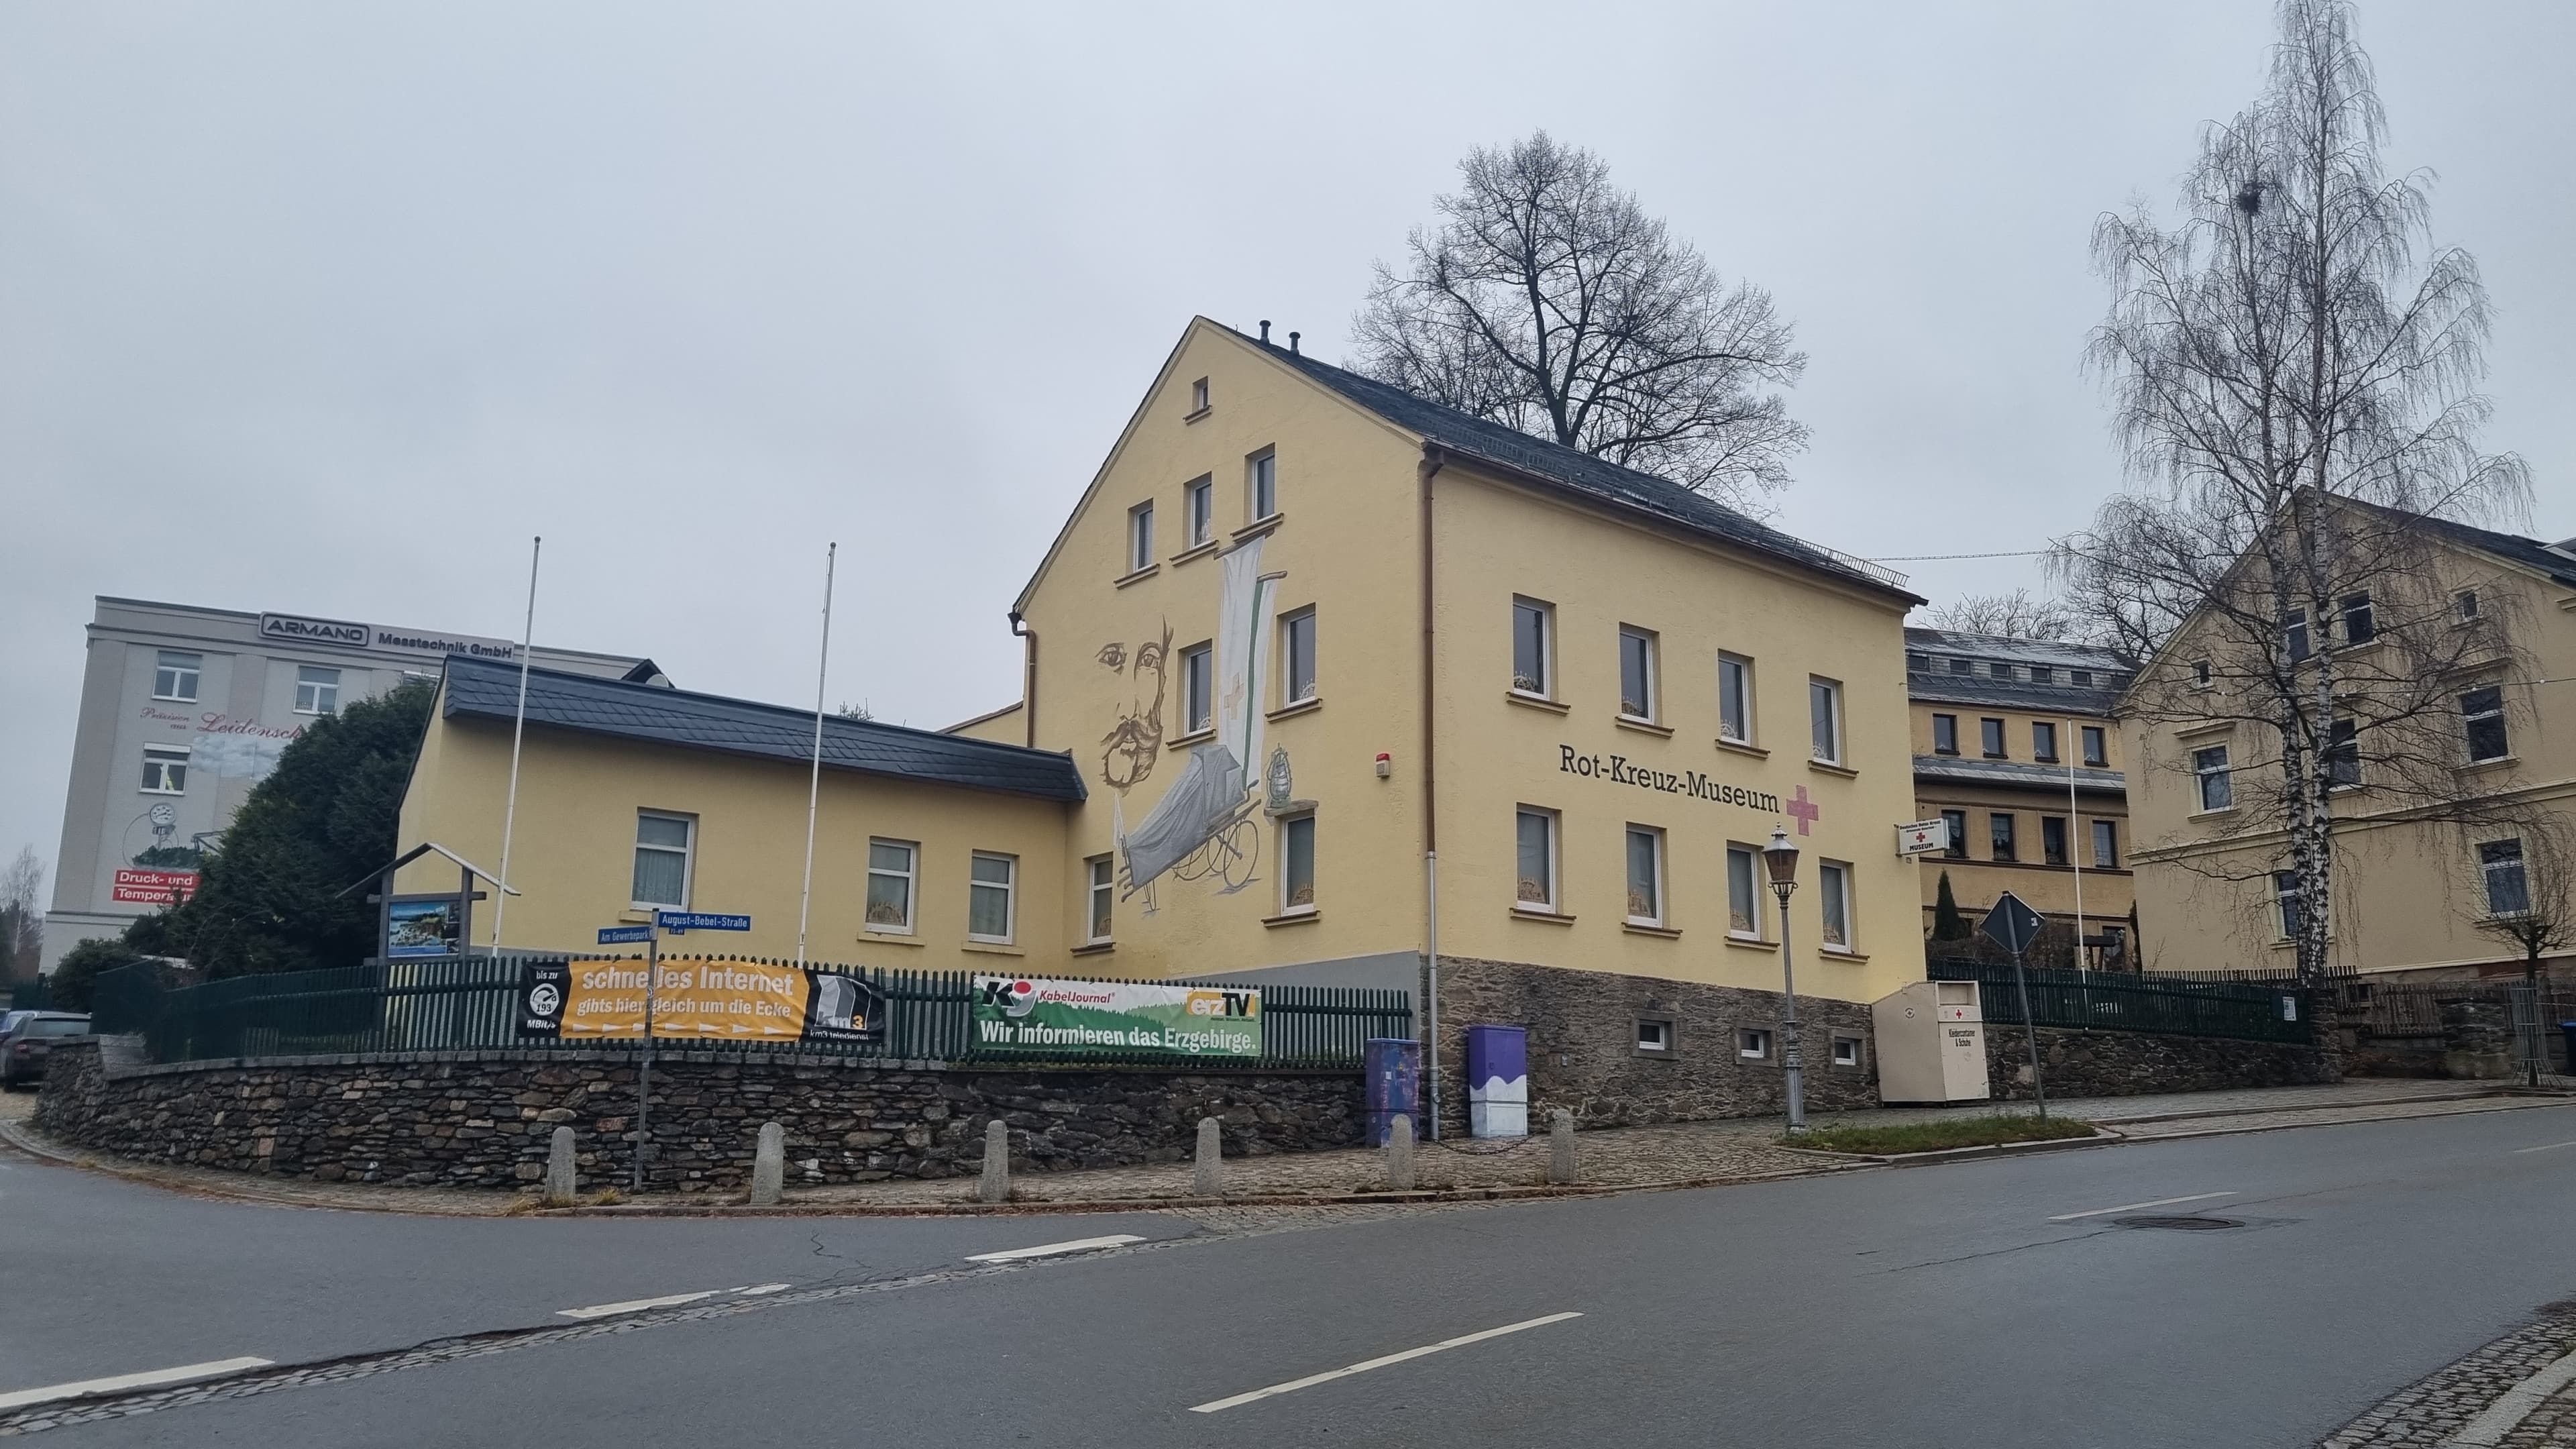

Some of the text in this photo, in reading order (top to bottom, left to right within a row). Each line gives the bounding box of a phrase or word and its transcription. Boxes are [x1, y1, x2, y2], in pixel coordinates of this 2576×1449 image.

[268, 619, 513, 659] ARMANO Messtechnik GmbH
[1559, 744, 1780, 814] Rot-Kreuz-Museum
[1909, 843, 1933, 851] MUSEUM
[119, 872, 193, 886] Druck- und
[118, 888, 193, 902] Temperaur
[662, 914, 748, 928] August-Bebel-Straße
[601, 930, 649, 942] Am Gewerbepark
[537, 971, 547, 979] bis
[699, 966, 794, 996] Internet
[537, 1003, 551, 1012] 193
[577, 998, 612, 1016] gibts
[616, 998, 645, 1013] hier
[700, 1000, 725, 1014] um
[729, 998, 752, 1015] die
[755, 1000, 791, 1018] Ecke
[810, 1030, 869, 1040] km3 teledienst
[980, 1020, 1256, 1053] Wir informieren das Erzgebirge.
